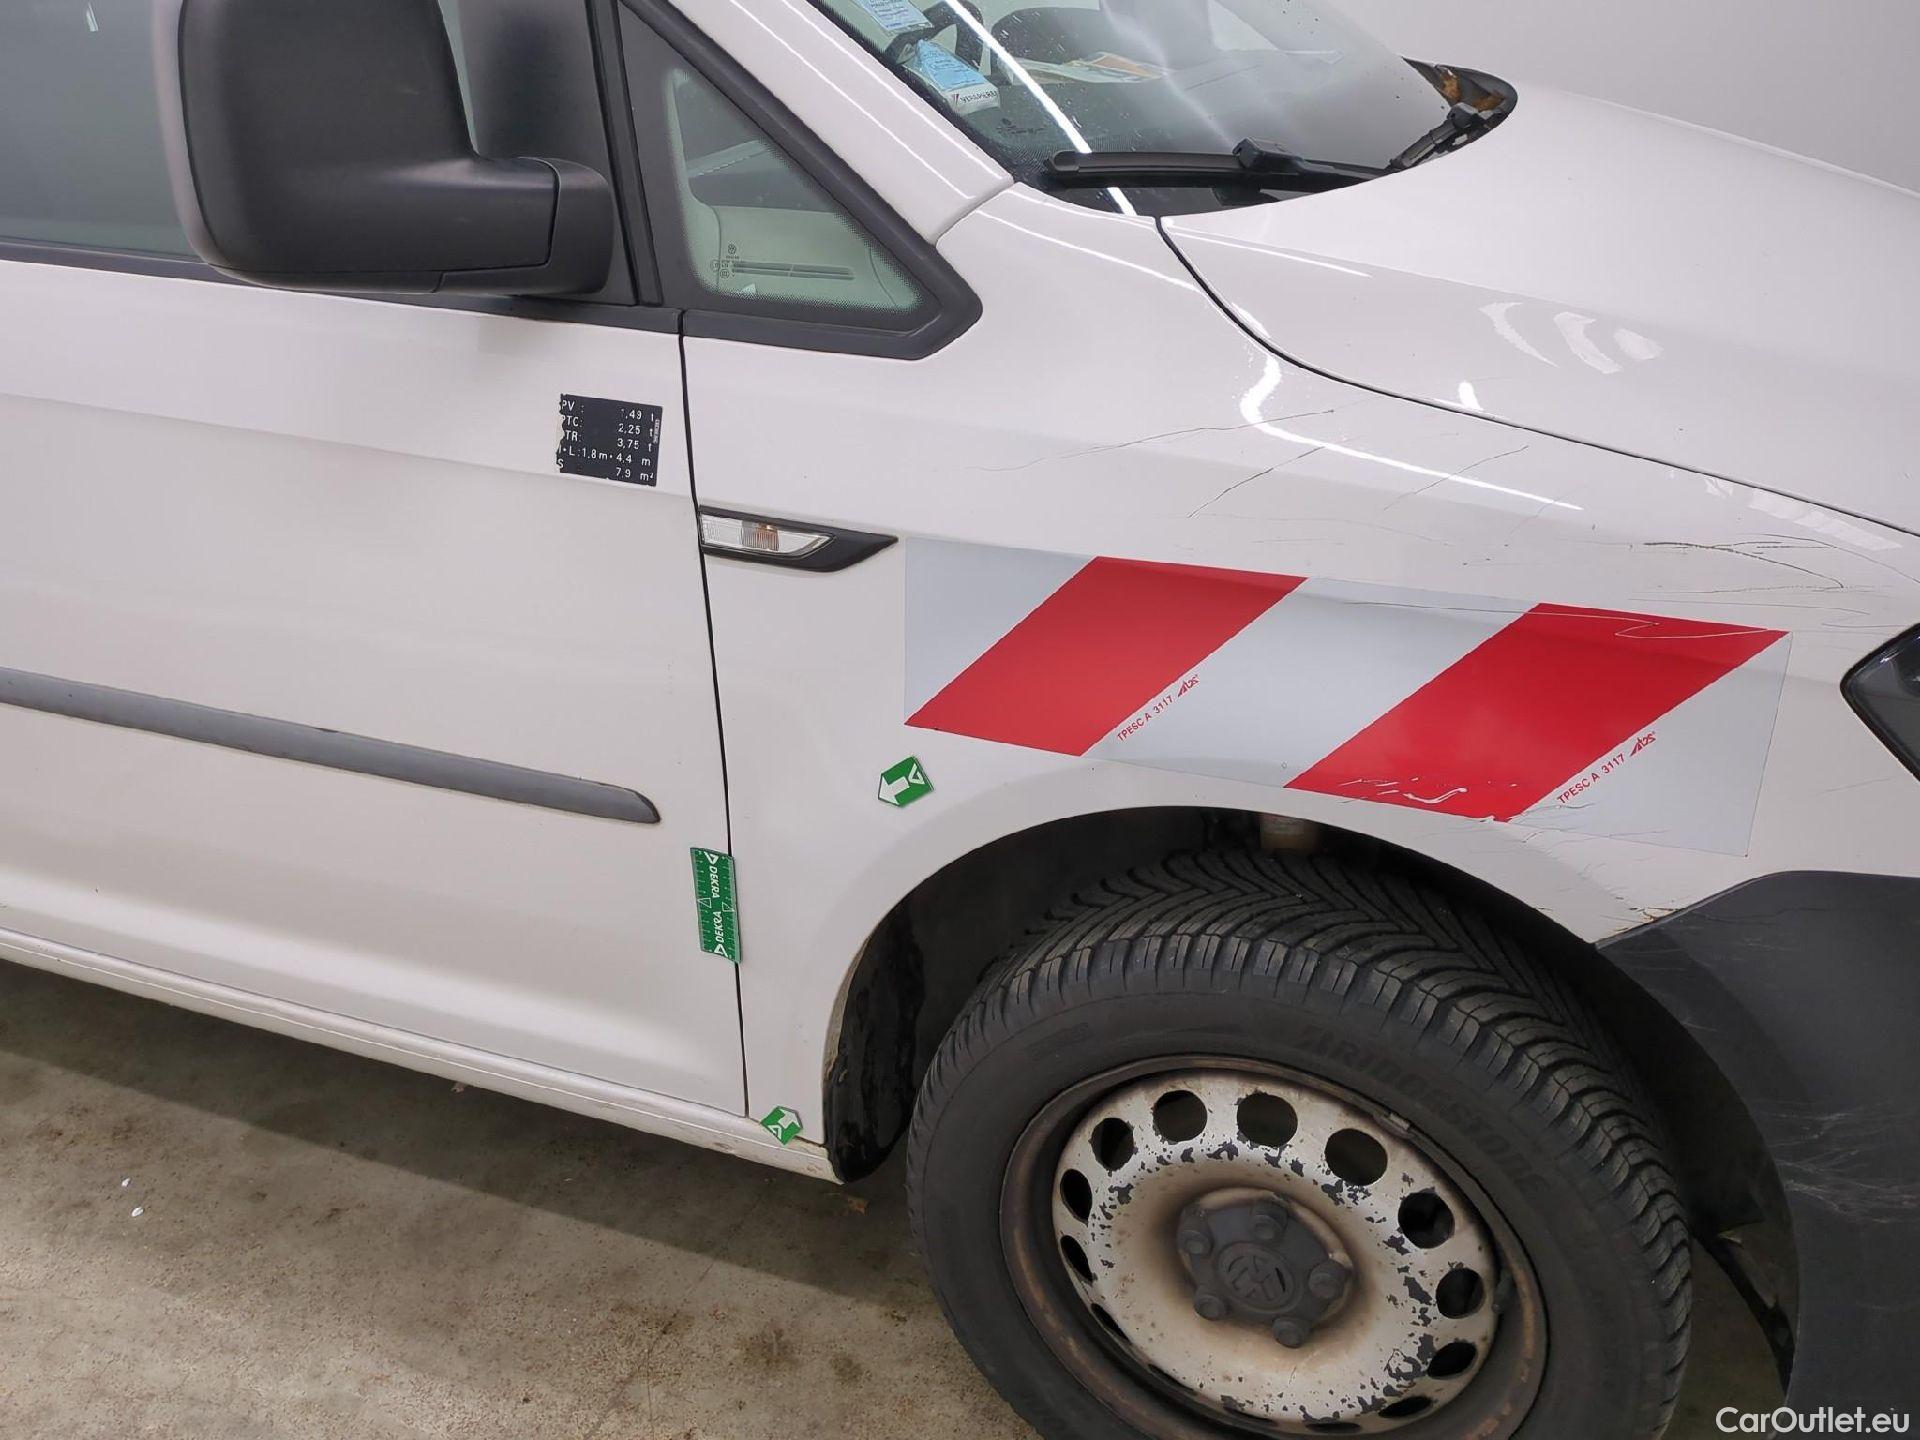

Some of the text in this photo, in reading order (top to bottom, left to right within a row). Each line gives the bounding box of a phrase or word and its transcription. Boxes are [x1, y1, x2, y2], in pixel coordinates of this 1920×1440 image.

[620, 408, 642, 420] ,49
[1117, 718, 1145, 741] TPESC
[1145, 712, 1152, 722] A
[1153, 695, 1174, 714] 3117
[1557, 778, 1591, 804] TPESC
[1591, 772, 1600, 782] A
[1601, 753, 1626, 774] 3117
[709, 865, 721, 898] DEKRA
[712, 911, 725, 943] DEKRA
